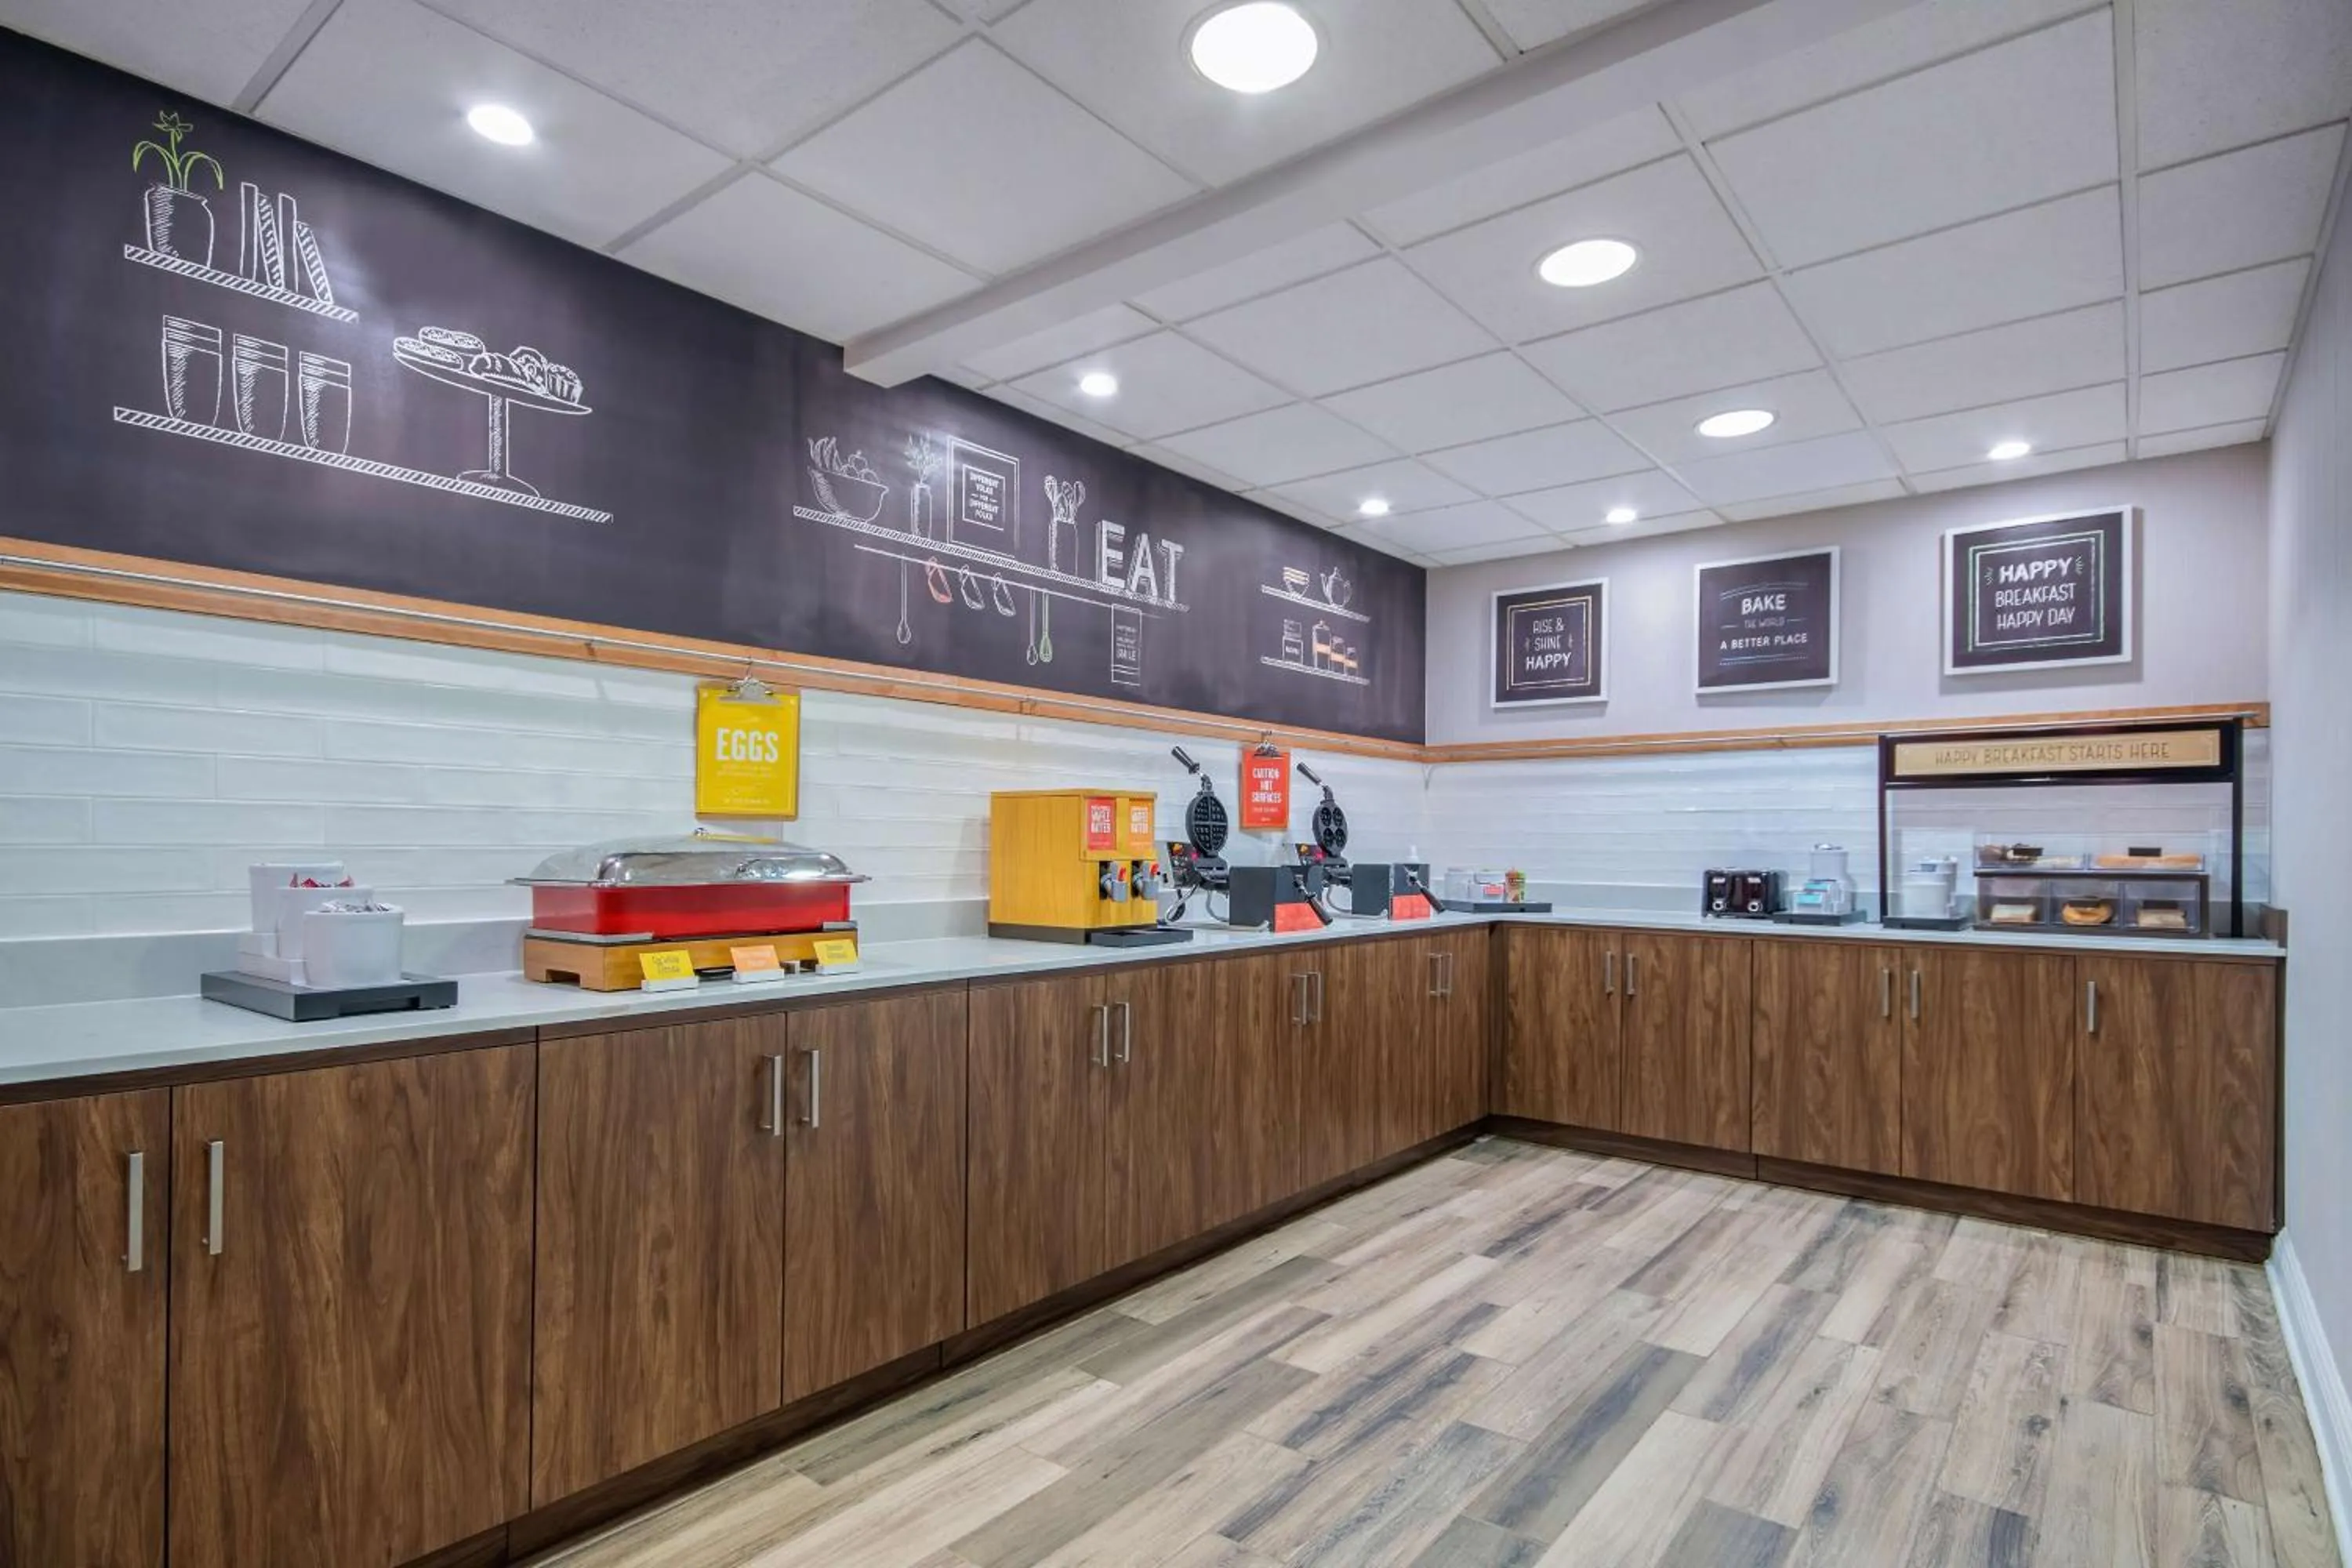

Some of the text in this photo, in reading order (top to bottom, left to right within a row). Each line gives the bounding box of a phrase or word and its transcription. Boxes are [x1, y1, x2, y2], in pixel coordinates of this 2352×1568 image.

[1095, 520, 1185, 604] EAT
[1999, 557, 2072, 584] HAPPY
[1741, 593, 1787, 615] BAKE
[1995, 583, 2077, 608] BREAKFAST
[1533, 617, 1565, 634] RISE &
[1997, 606, 2076, 630] HAPPY DAY
[1534, 634, 1562, 652] SHINE
[1719, 632, 1808, 650] A BETTER PLACE
[1526, 652, 1572, 672] HAPPY
[716, 727, 779, 763] EGGS
[1936, 742, 2170, 766] HAPPY BREAKFAST STARTS HERE
